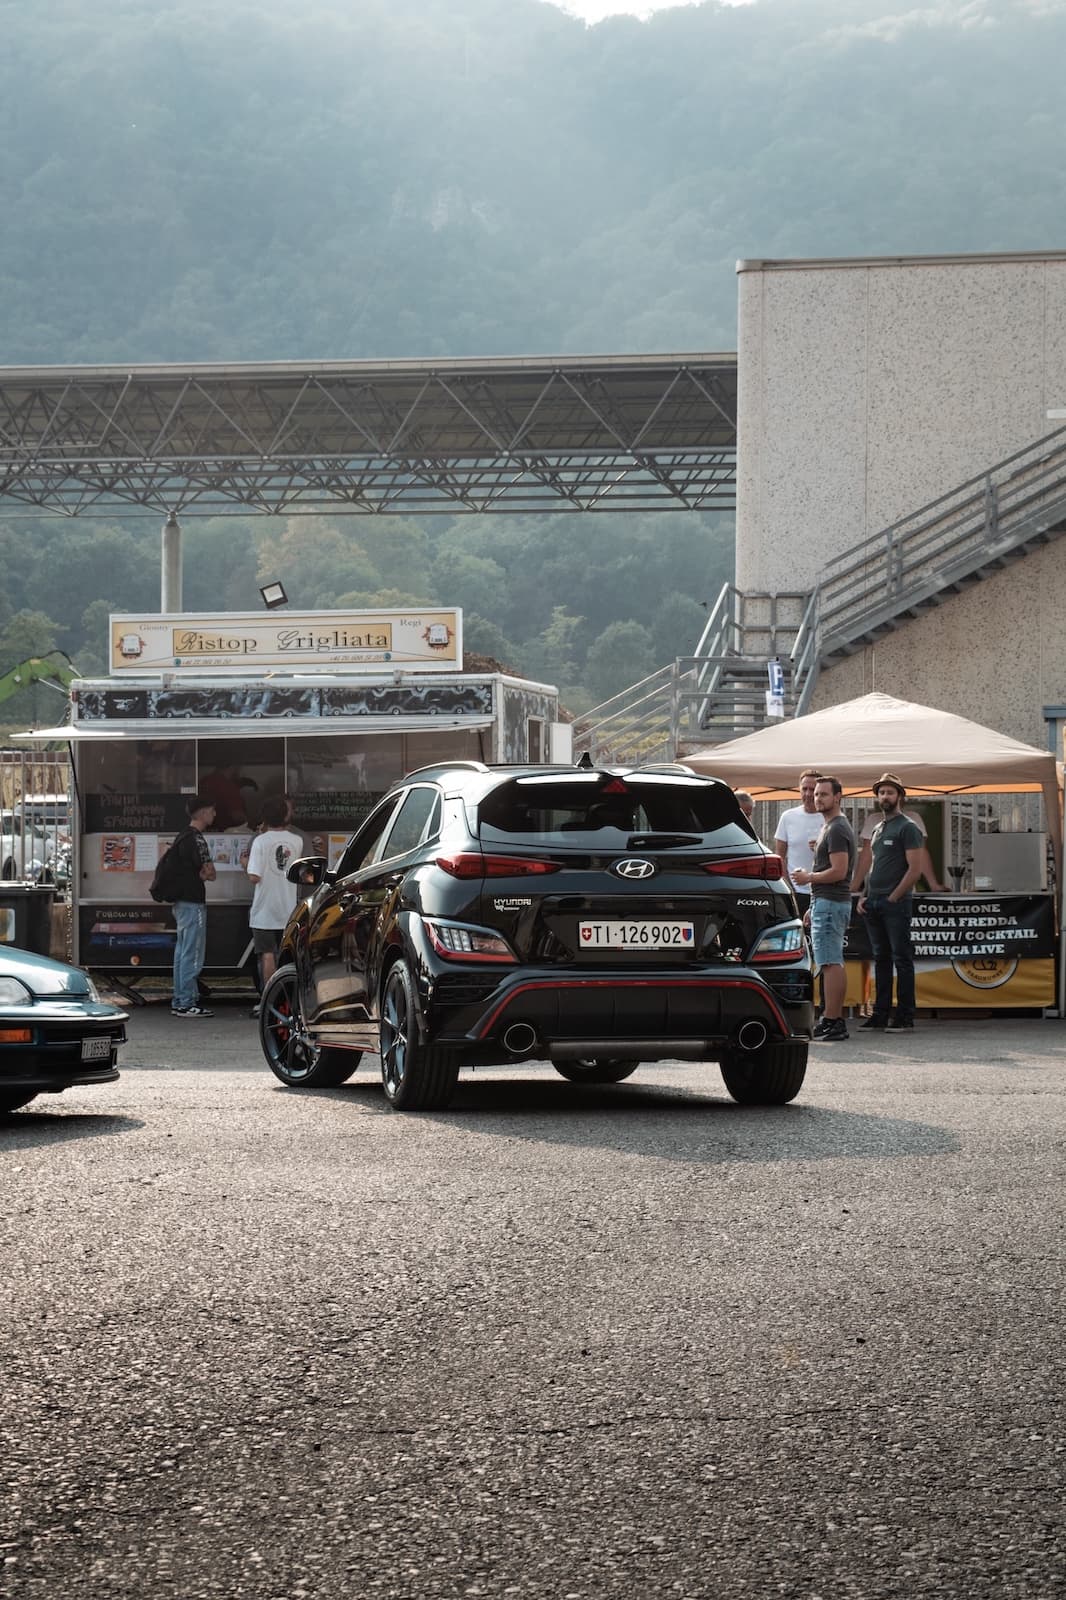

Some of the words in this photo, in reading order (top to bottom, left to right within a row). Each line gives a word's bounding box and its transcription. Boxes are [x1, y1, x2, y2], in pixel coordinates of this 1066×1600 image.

[176, 631, 257, 653] Ristop
[277, 630, 388, 652] Grigliata
[493, 898, 531, 906] HYUNDAI
[918, 904, 1000, 914] COLAZIONE
[959, 916, 1018, 927] FREDDA
[965, 929, 1038, 940] COCKTAIL
[915, 945, 969, 955] MUSICA
[972, 944, 1005, 954] LIVE
